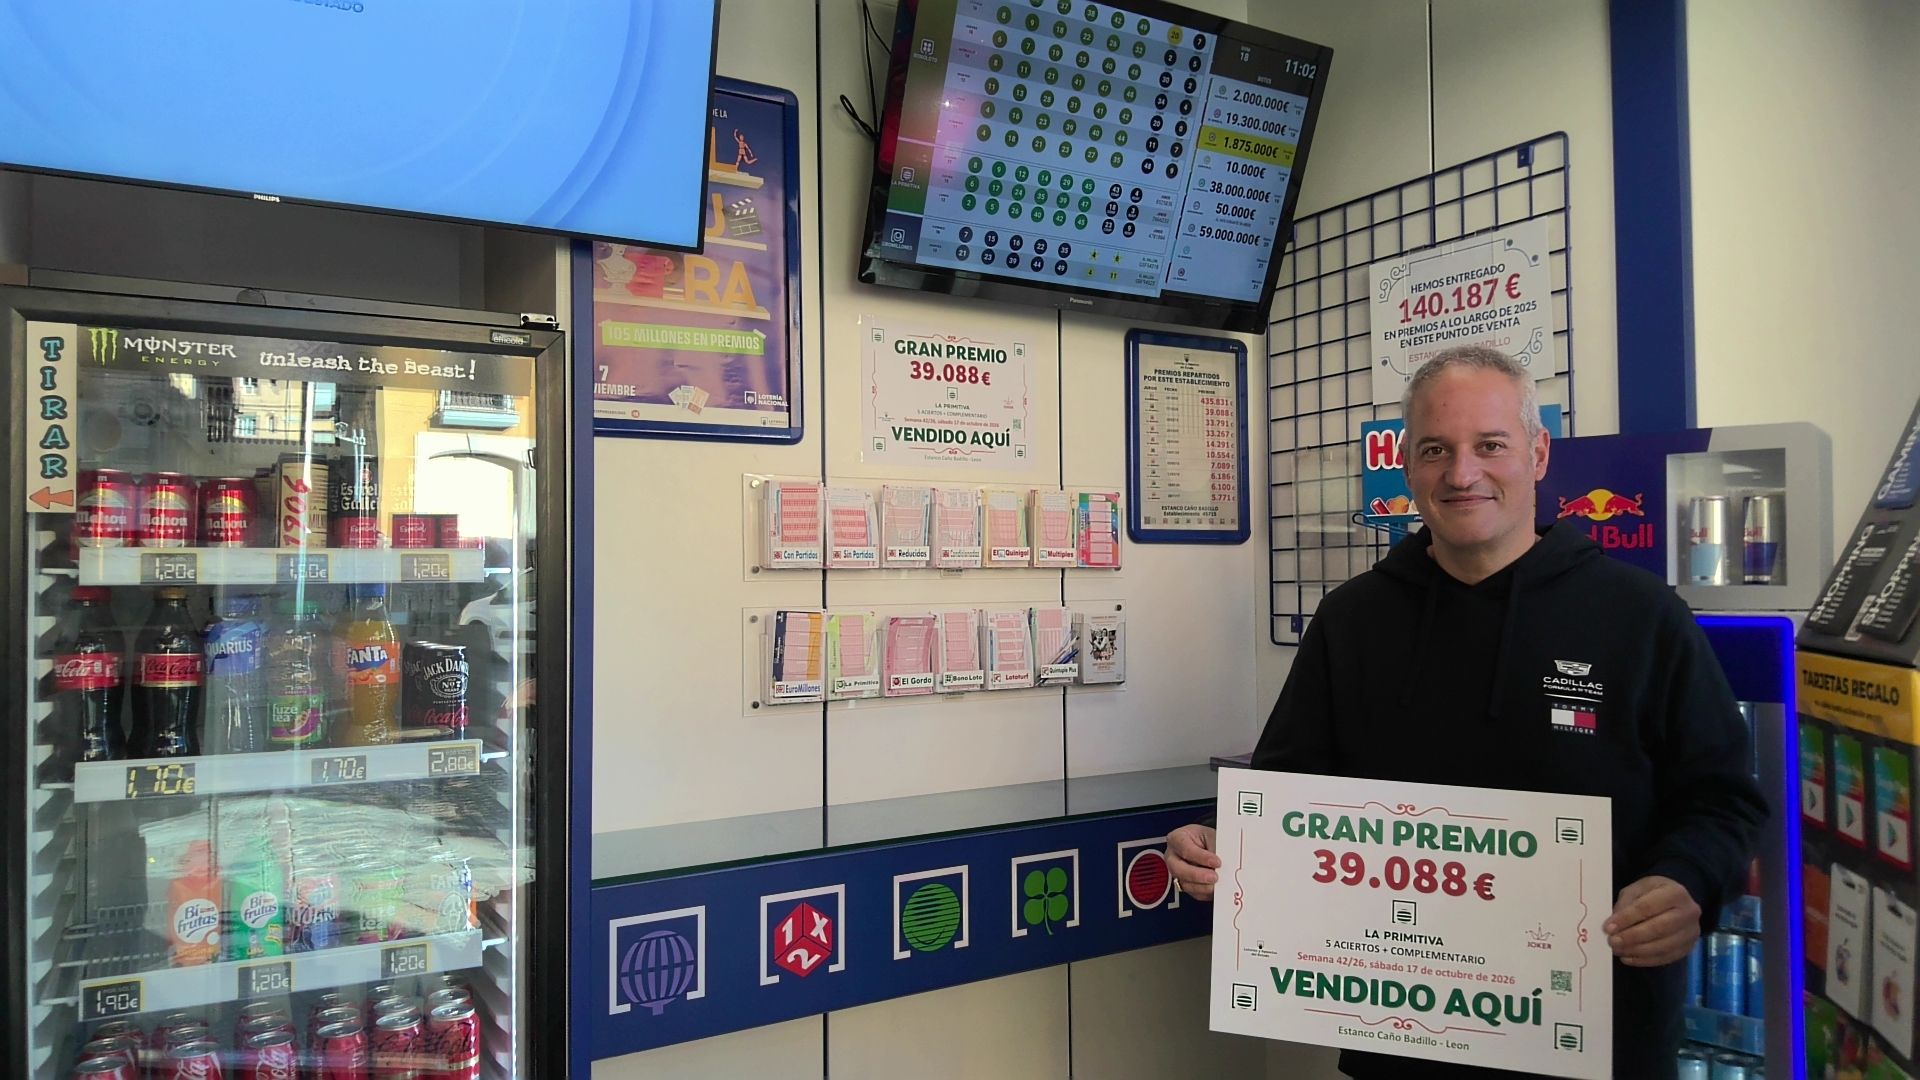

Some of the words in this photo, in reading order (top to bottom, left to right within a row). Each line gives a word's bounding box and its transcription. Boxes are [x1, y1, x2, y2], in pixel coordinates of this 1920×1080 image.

[1285, 59, 1317, 79] 11:02
[1233, 89, 1290, 113] 2.000.000€
[1226, 112, 1287, 136] 19.300.000€
[1224, 137, 1279, 158] 1.875.000€
[1226, 161, 1266, 179] 10.000€
[1209, 181, 1271, 203] 38.000.000€
[1216, 202, 1257, 220] 50.000€
[1199, 226, 1261, 247] 59.000.000€
[1410, 277, 1445, 294] HEMOS
[1446, 263, 1506, 286] ENTREGADO
[1398, 276, 1499, 324] 140.187
[1384, 330, 1397, 341] EN
[1399, 322, 1439, 338] PREMIOS
[1440, 320, 1448, 329] A
[1449, 316, 1462, 328] LO
[1463, 309, 1498, 325] LARGO
[1499, 307, 1512, 318] DE
[1513, 300, 1537, 315] 2025
[608, 327, 631, 342] 105
[633, 329, 691, 346] MILLONES
[693, 331, 709, 347] EN
[710, 333, 760, 351] PREMIOS
[1400, 338, 1412, 349] EN
[1413, 334, 1434, 347] ESTE
[1436, 326, 1470, 340] PUNTO
[1471, 323, 1485, 335] DE
[1485, 316, 1521, 331] VENTA
[141, 356, 221, 367] ENERGY
[894, 339, 943, 359] GRAN
[946, 344, 1008, 364] PREMIO
[259, 351, 353, 372] Unleash
[358, 355, 399, 375] the
[404, 357, 477, 381] Beast!
[1154, 368, 1181, 377] PREMIOS
[1183, 371, 1221, 380] REPARTIDOS
[1175, 377, 1230, 388] ESTABLECIMIENTO
[40, 336, 70, 480] TIRAR
[758, 393, 783, 402] LOTERÍA
[758, 399, 789, 409] NACIONAL
[891, 426, 967, 445] VENDIDO
[970, 428, 1010, 449] AQUÍ
[1602, 523, 1654, 549] Bull
[783, 551, 795, 560] Con
[795, 551, 818, 560] Partidos
[843, 550, 852, 559] Sin
[852, 550, 875, 560] Partidos
[898, 549, 928, 559] Reducidos
[992, 549, 999, 557] El
[1005, 549, 1030, 559] Quinigol
[155, 557, 196, 582] 1,20€
[413, 557, 449, 580] 1,20€
[347, 645, 389, 665] FANTA
[423, 662, 446, 681] JACK
[910, 676, 932, 685] Gordo
[968, 674, 983, 682] Loto
[785, 683, 821, 695] EuroMillones
[1543, 676, 1604, 691] CADILLAC
[1802, 669, 1850, 696] TARJETAS
[1851, 678, 1900, 707] REGALO
[272, 703, 299, 717] fuze
[272, 713, 292, 723] tea
[1554, 703, 1595, 713] TOMMY
[1553, 725, 1594, 735] HILFIGER
[321, 756, 366, 782] 1,70€
[430, 751, 476, 774] 2,80€
[1281, 810, 1384, 845] GRAN
[1392, 820, 1538, 859] PREMIO
[184, 905, 200, 920] Bi
[249, 895, 263, 909] Bi
[243, 904, 278, 922] frutas
[177, 913, 217, 935] frutas
[1365, 928, 1380, 939] LA
[1383, 931, 1444, 946] PRIMITIVA
[1325, 939, 1332, 948] 5
[1333, 940, 1380, 954] ACIERTOS
[1390, 946, 1486, 965] COMPLEMENTARIO
[390, 952, 426, 975] 1,20€
[1297, 951, 1334, 964] Semana
[1336, 956, 1367, 969] 42/26,
[1369, 960, 1404, 972] sábado
[1407, 964, 1418, 973] 17
[1420, 966, 1433, 976] de
[1435, 969, 1473, 981] octubre
[1476, 972, 1489, 982] de
[1491, 974, 1516, 985] 2026
[251, 970, 290, 994] 1,20€
[1270, 966, 1436, 1012] VENDIDO
[1443, 987, 1543, 1027] AQUÍ
[1338, 1025, 1375, 1039] Estanco
[1377, 1031, 1402, 1042] Caño
[1404, 1034, 1437, 1047] Badillo
[1446, 1040, 1470, 1051] Leon
